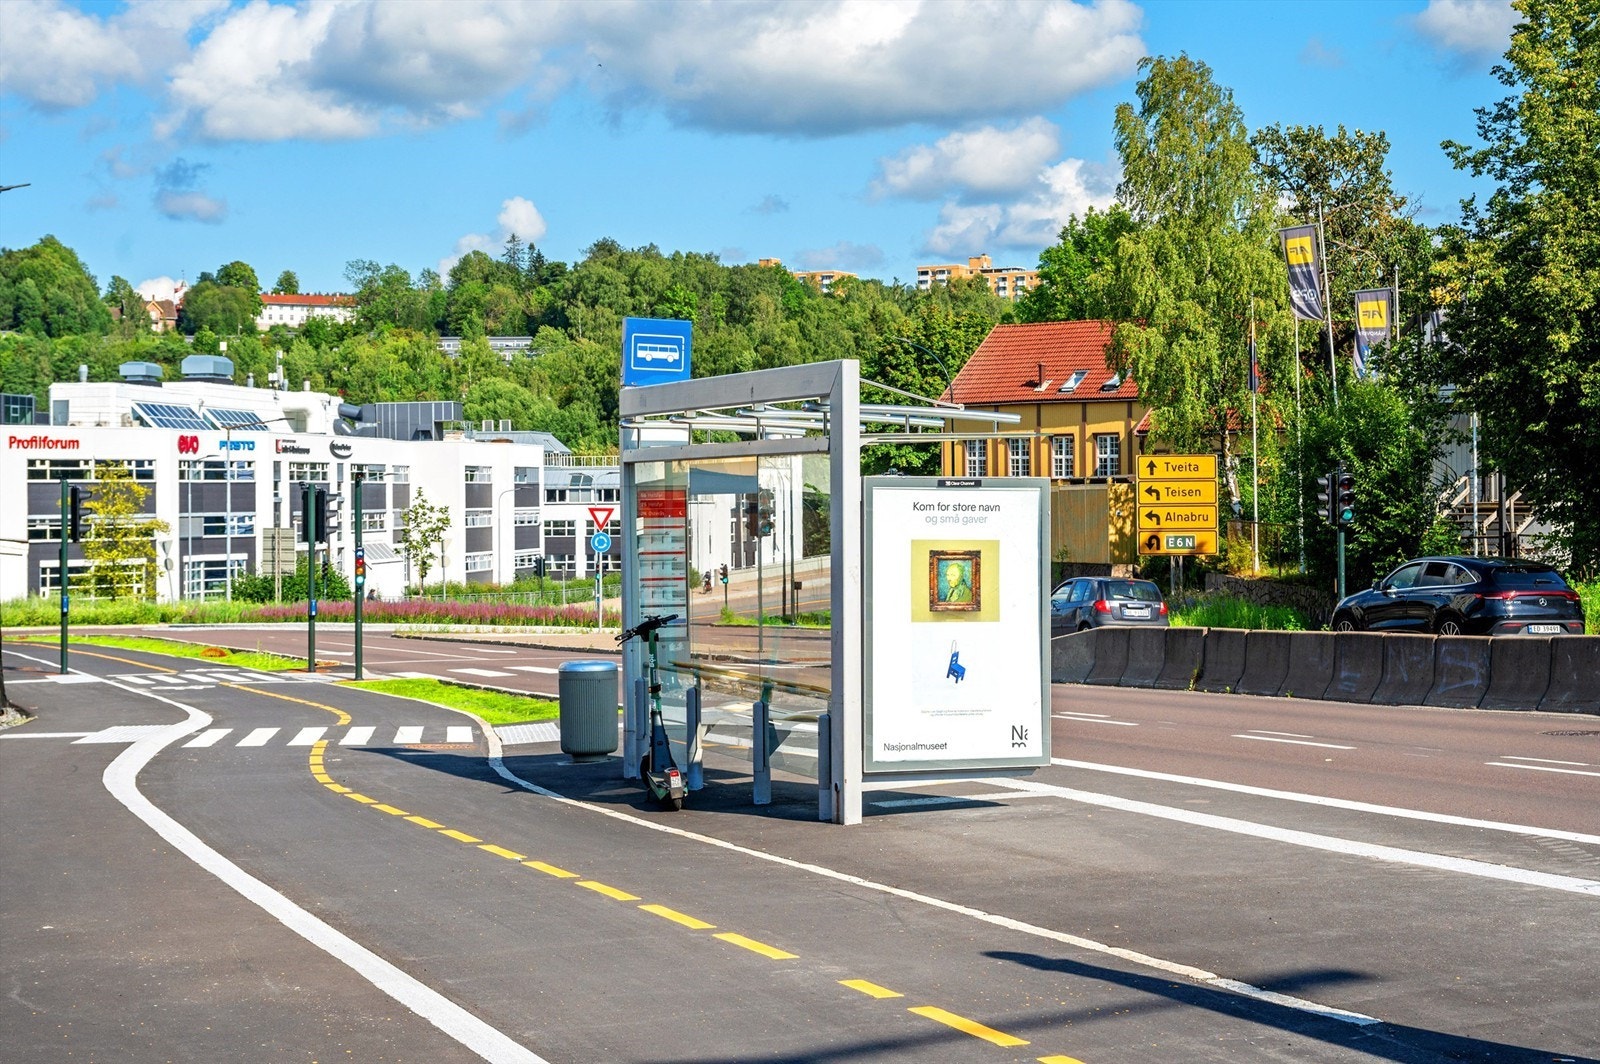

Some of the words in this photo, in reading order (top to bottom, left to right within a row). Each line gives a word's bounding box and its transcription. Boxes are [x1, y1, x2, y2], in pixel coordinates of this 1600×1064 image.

[8, 435, 80, 449] Profilforum
[1164, 461, 1200, 472] Tveita
[1164, 486, 1202, 497] Teisen
[912, 501, 935, 512] Kom
[937, 501, 951, 512] for
[952, 502, 977, 512] store
[978, 503, 1001, 512] navn
[925, 515, 938, 526] og
[940, 513, 960, 524] små
[962, 515, 988, 526] gaver
[1164, 511, 1209, 522] Alnabru
[883, 742, 948, 753] Nasjonalmuseet
